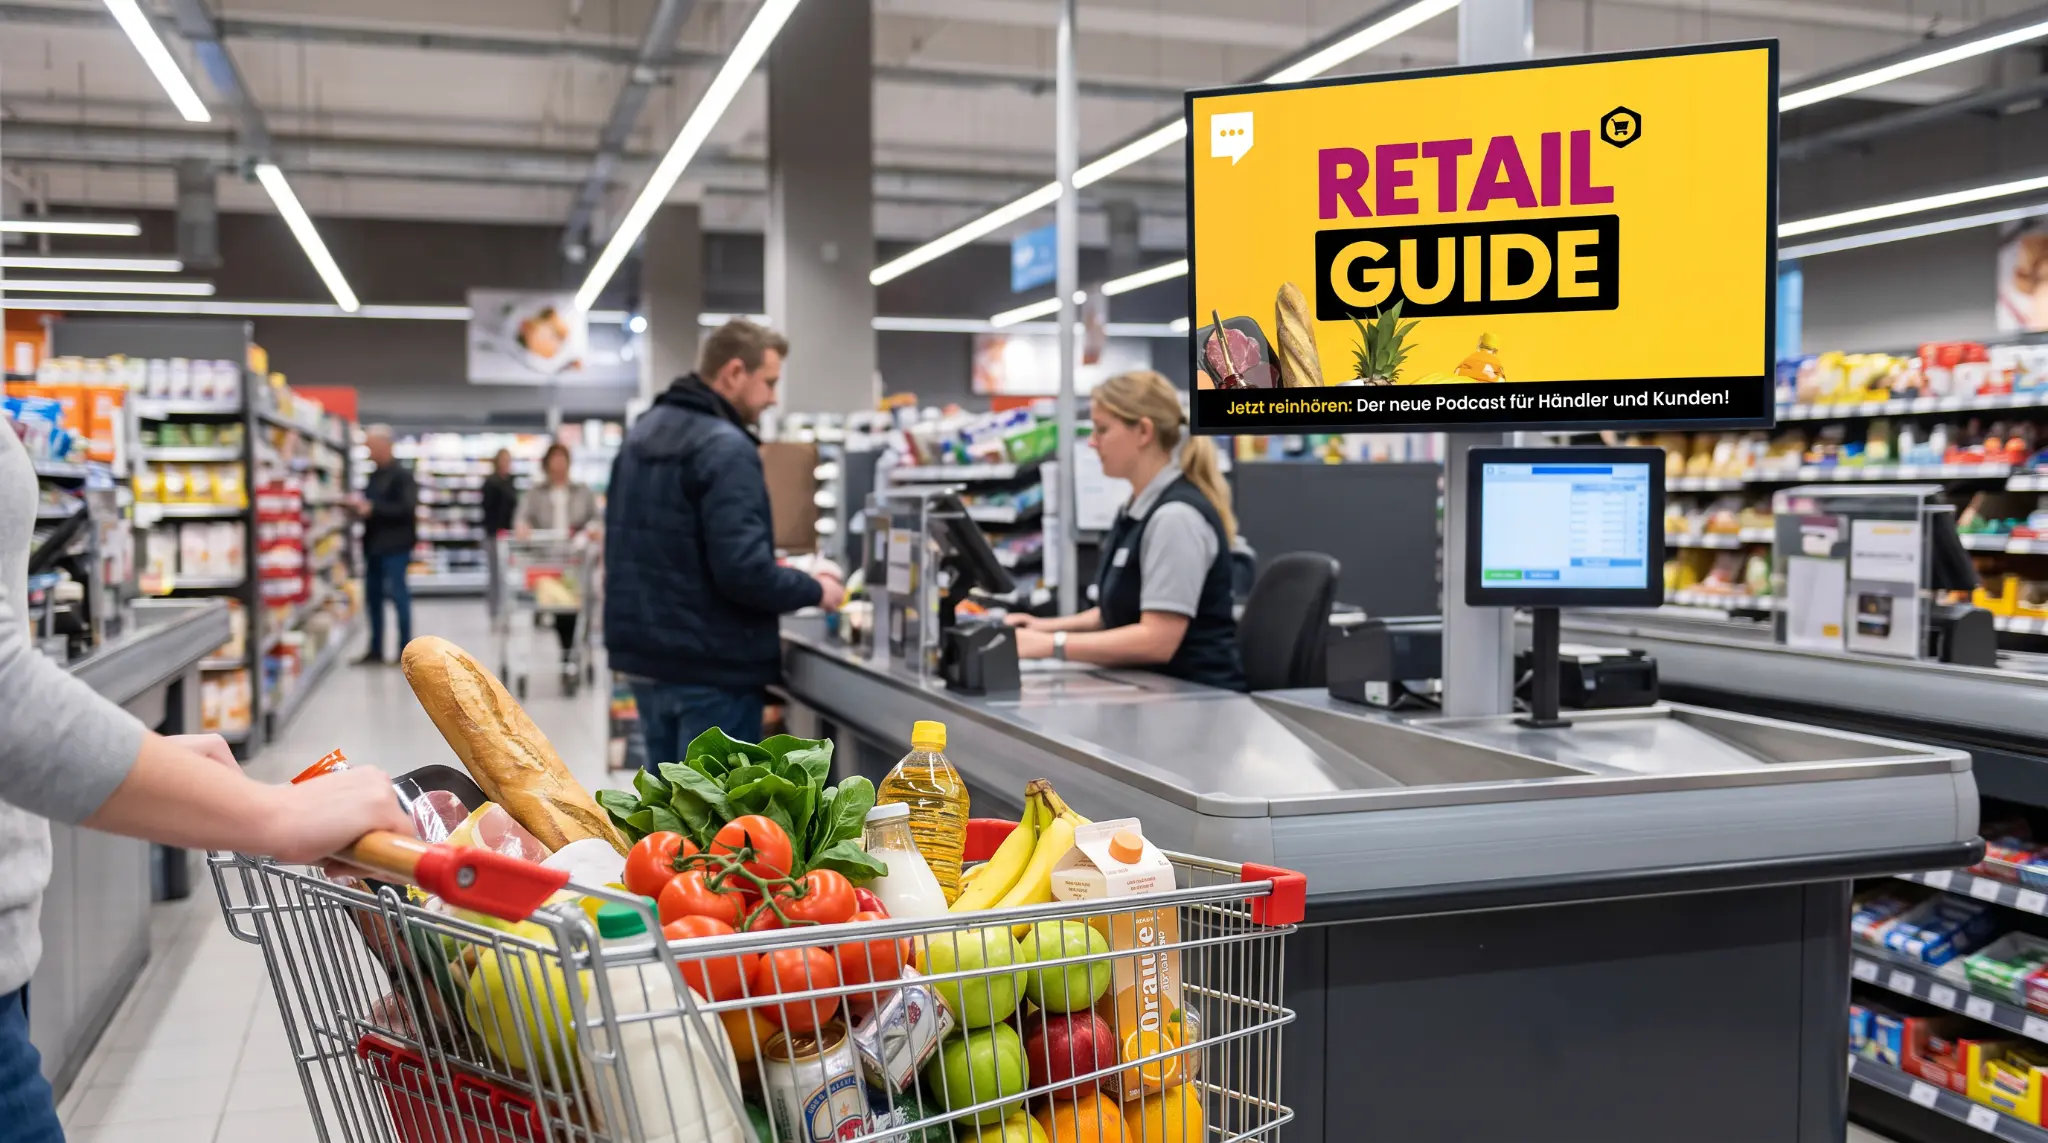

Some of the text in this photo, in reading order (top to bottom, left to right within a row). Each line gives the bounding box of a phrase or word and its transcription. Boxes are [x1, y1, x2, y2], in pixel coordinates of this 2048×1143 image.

[1318, 130, 1614, 219] RETAIL
[1330, 229, 1600, 308] GUIDE
[1226, 389, 1729, 415] Jetzt reinhören: Der neue Podcast für Händler und Kunden!
